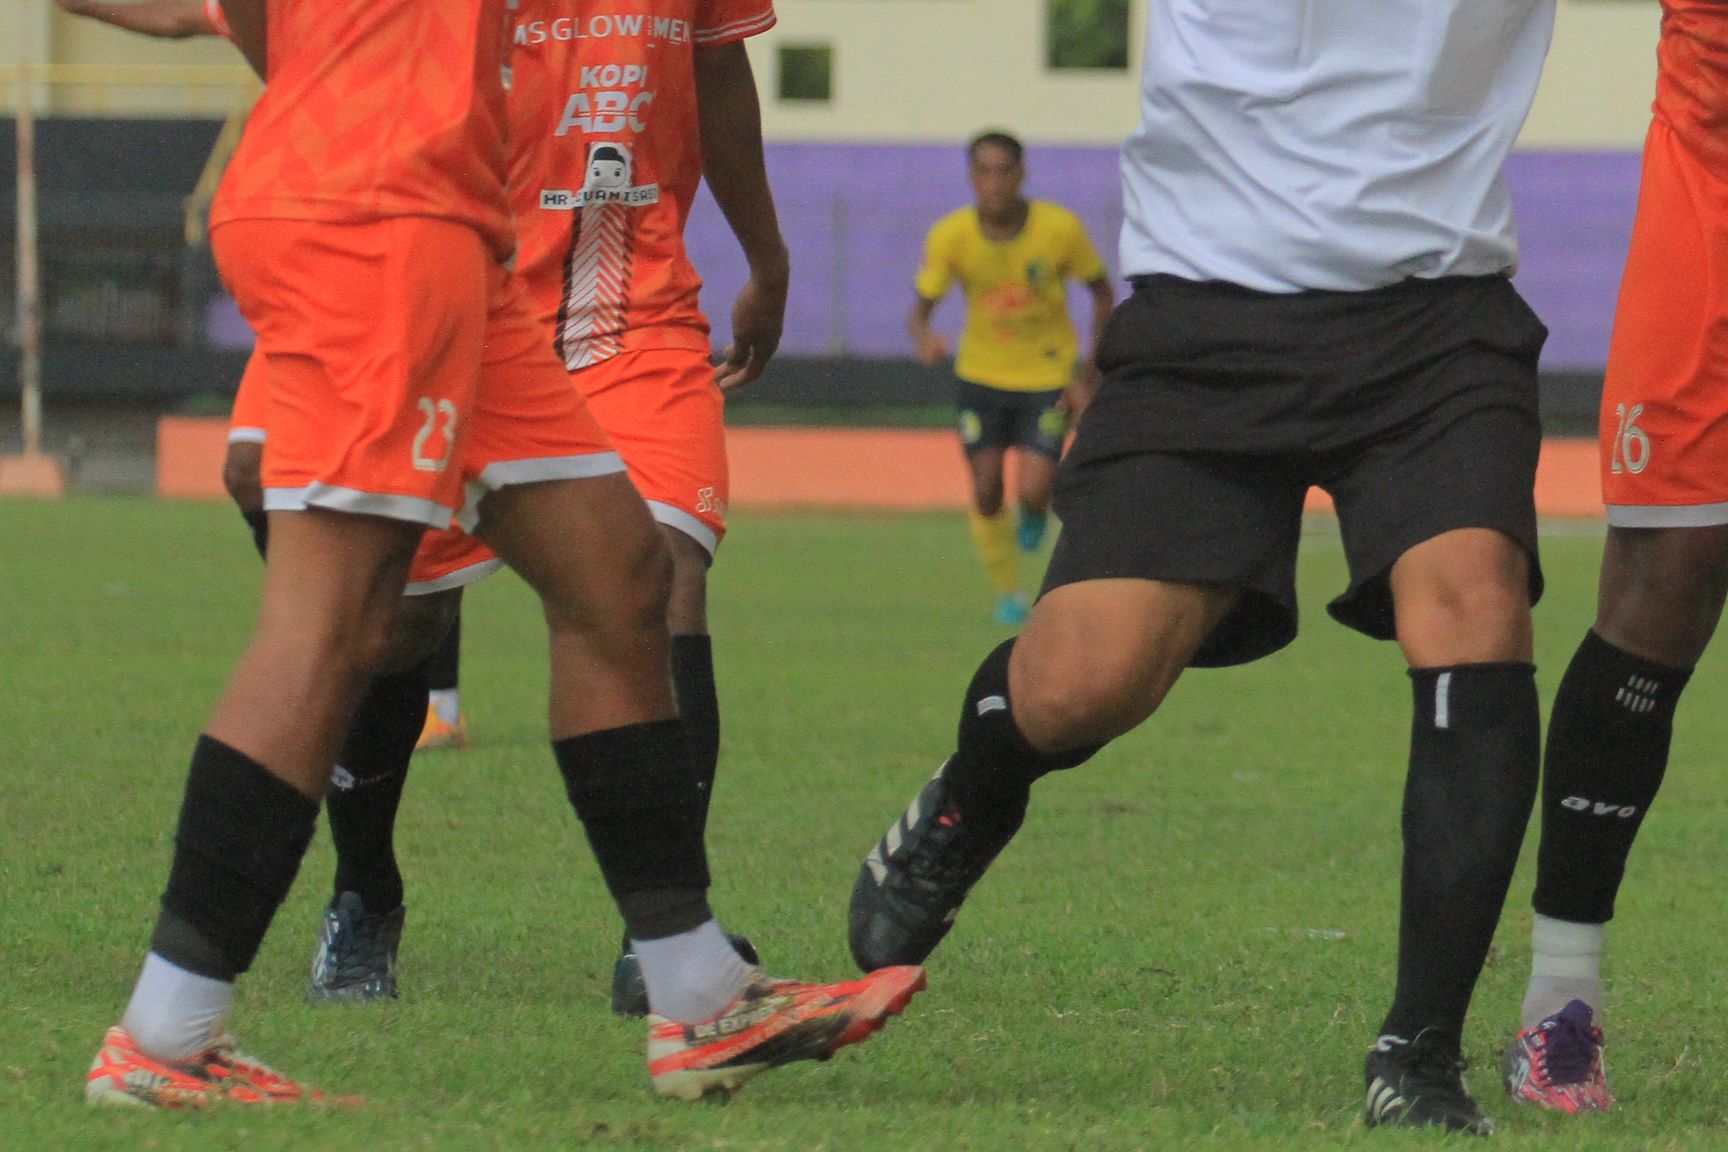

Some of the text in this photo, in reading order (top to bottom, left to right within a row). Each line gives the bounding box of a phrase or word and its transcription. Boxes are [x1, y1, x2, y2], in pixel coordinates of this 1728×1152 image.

[551, 14, 644, 42] GLOW
[580, 64, 648, 89] KOPI
[553, 90, 656, 137] ABC
[411, 395, 458, 473] 23
